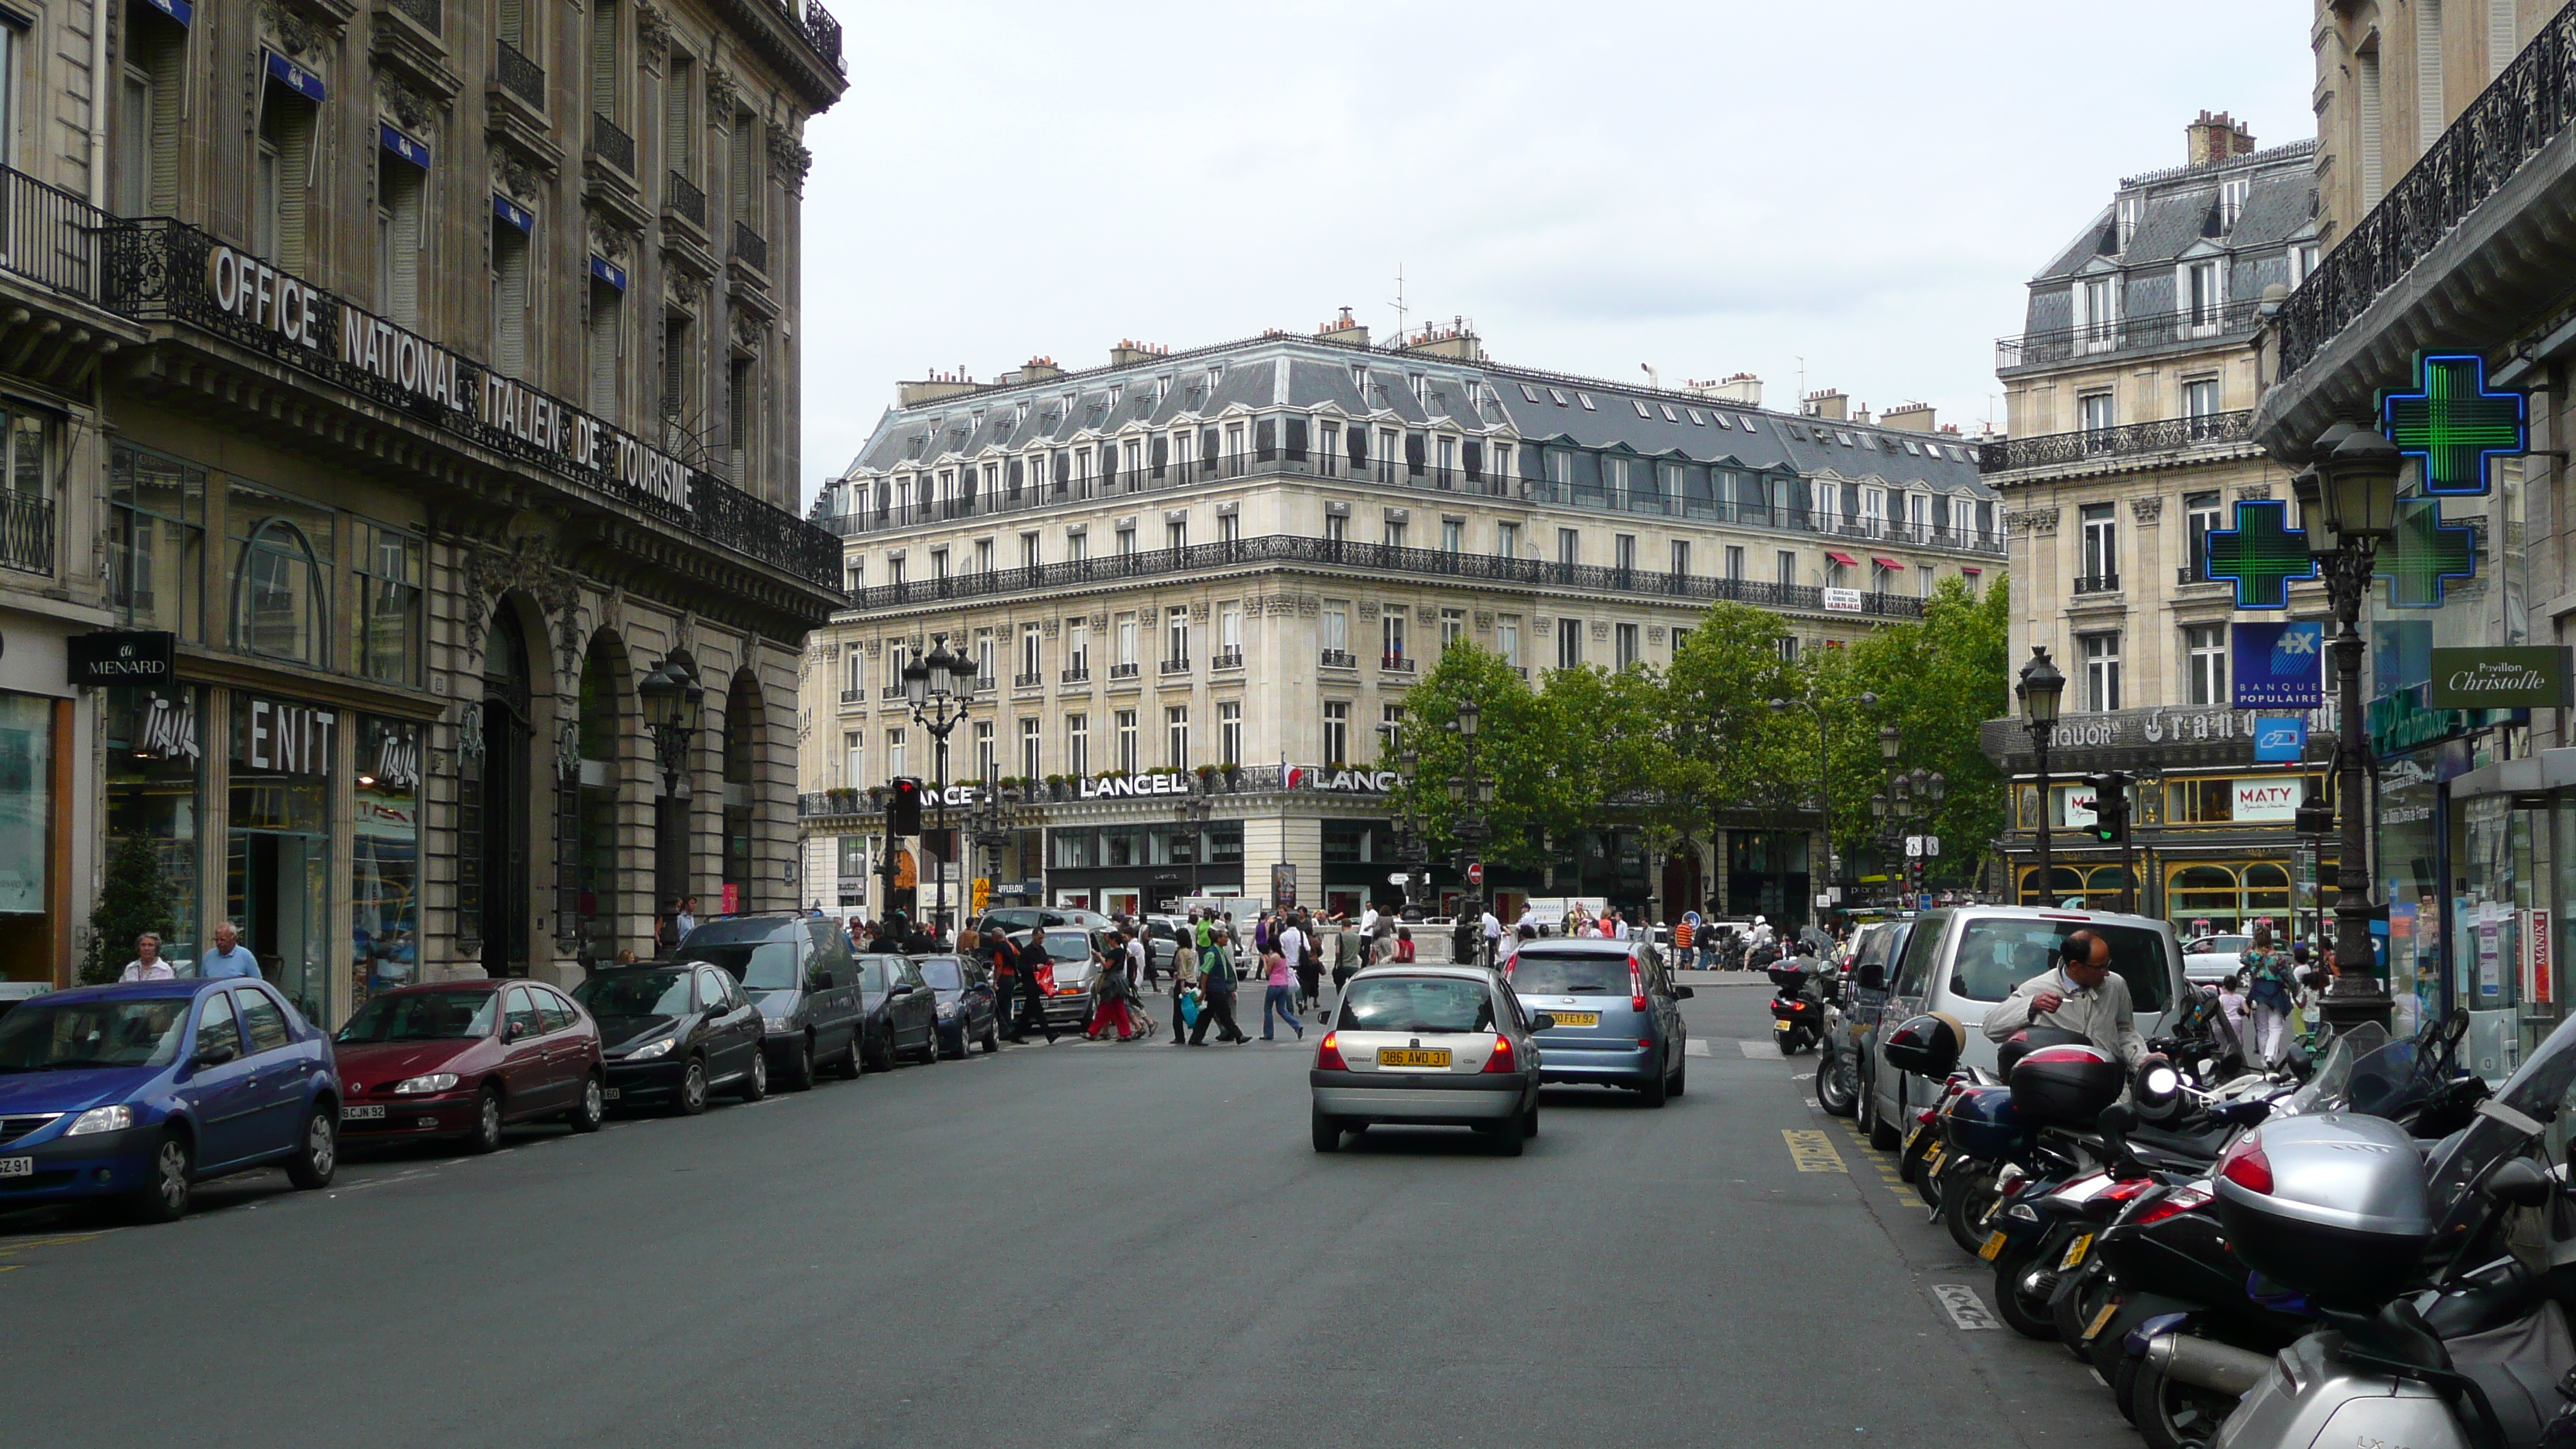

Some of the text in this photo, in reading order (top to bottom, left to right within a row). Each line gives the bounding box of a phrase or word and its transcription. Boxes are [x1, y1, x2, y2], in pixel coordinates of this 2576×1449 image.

[209, 246, 694, 512] OFFICE NATIONAL ITALIEN DE TOURISME
[88, 660, 165, 675] MENARD
[2478, 662, 2523, 673] Pavillon
[2449, 670, 2546, 691] Christofle
[2239, 694, 2317, 703] POPULAIRE
[250, 701, 334, 776] ENIT
[1081, 773, 1188, 797] LANCEL
[2240, 787, 2292, 803] MATY
[2534, 921, 2545, 964] MANIX
[1565, 1014, 1581, 1023] FEY
[1583, 1013, 1594, 1023] 92
[1382, 1051, 1447, 1064] 386 AWD 31
[351, 1108, 369, 1118] CJN
[372, 1107, 384, 1116] 92
[15, 1160, 29, 1172] 91
